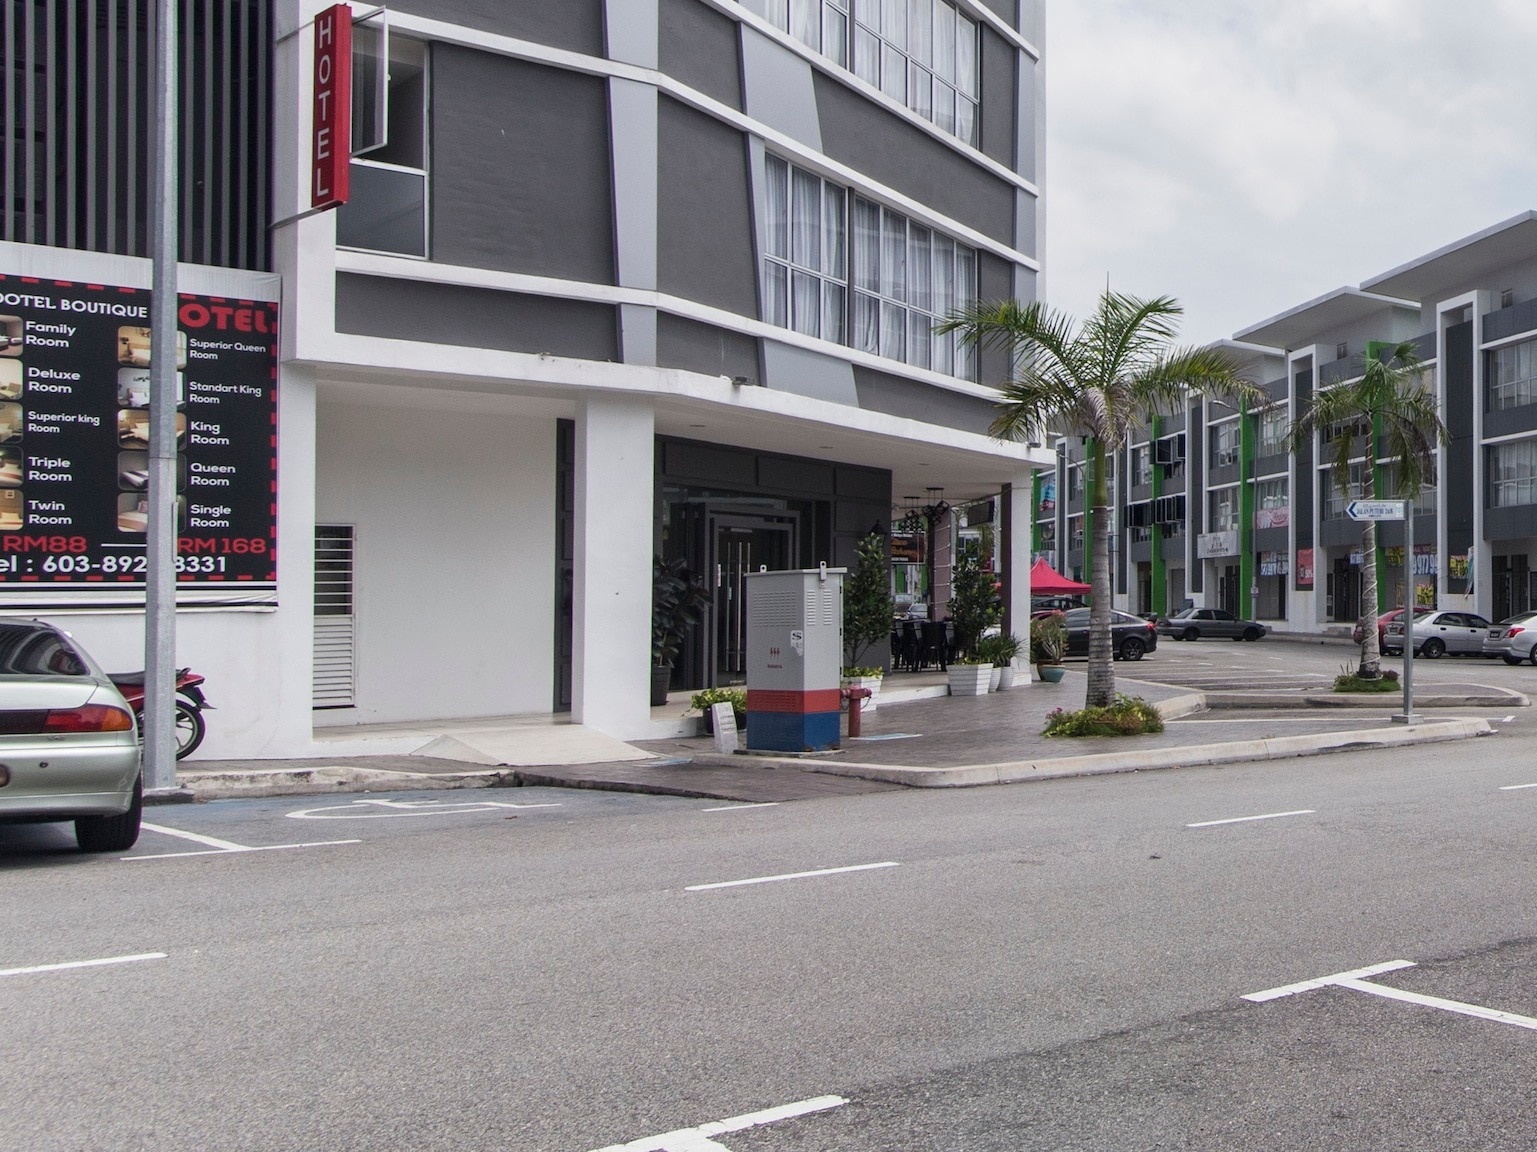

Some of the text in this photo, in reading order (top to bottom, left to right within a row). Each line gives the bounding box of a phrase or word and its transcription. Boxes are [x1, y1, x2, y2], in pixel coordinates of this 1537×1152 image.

[317, 16, 331, 196] HOTEL
[0, 293, 268, 333] OTEL BOUTIQUE OTEL
[26, 321, 76, 337] Family
[26, 333, 70, 347] Room
[190, 339, 265, 352] Superior Queen
[190, 350, 218, 359] Room
[29, 367, 80, 380] Deluxe
[29, 381, 71, 393] Room
[190, 382, 261, 397] Standart King
[190, 394, 219, 403] Room
[28, 411, 100, 426] Superior king
[28, 423, 60, 432] Room
[191, 421, 221, 435] King
[191, 435, 229, 444] Room
[28, 457, 71, 470] Triple
[191, 463, 235, 473] Queen
[29, 471, 72, 481] Room
[191, 476, 229, 486] Room
[29, 500, 65, 510] Twin
[191, 505, 231, 517] Single
[29, 514, 72, 524] Room
[191, 518, 229, 527] Room
[3, 535, 88, 553] RM88
[177, 538, 266, 553] RM 168
[0, 554, 17, 573] el
